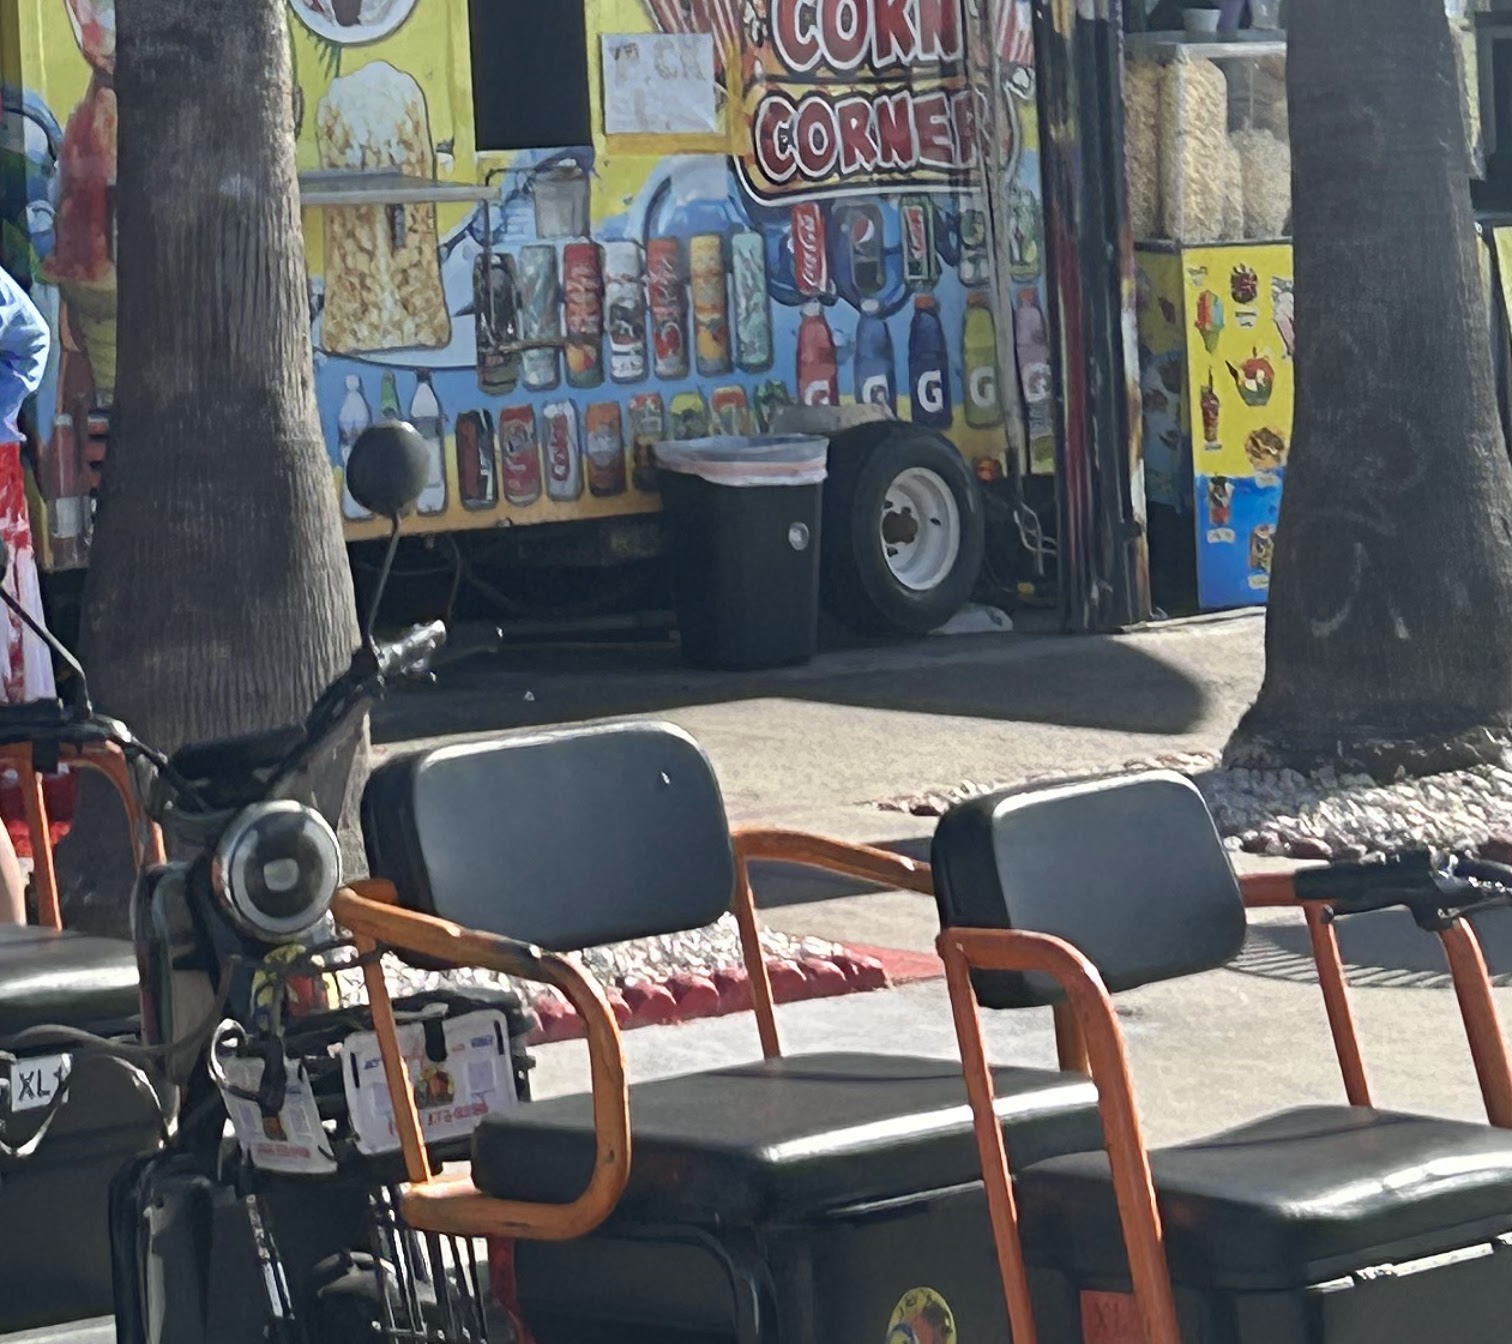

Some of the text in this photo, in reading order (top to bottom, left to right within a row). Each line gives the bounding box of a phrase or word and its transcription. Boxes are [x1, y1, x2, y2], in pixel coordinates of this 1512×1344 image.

[755, 91, 992, 183] CORNER
[917, 369, 944, 413] G
[970, 366, 996, 407] G
